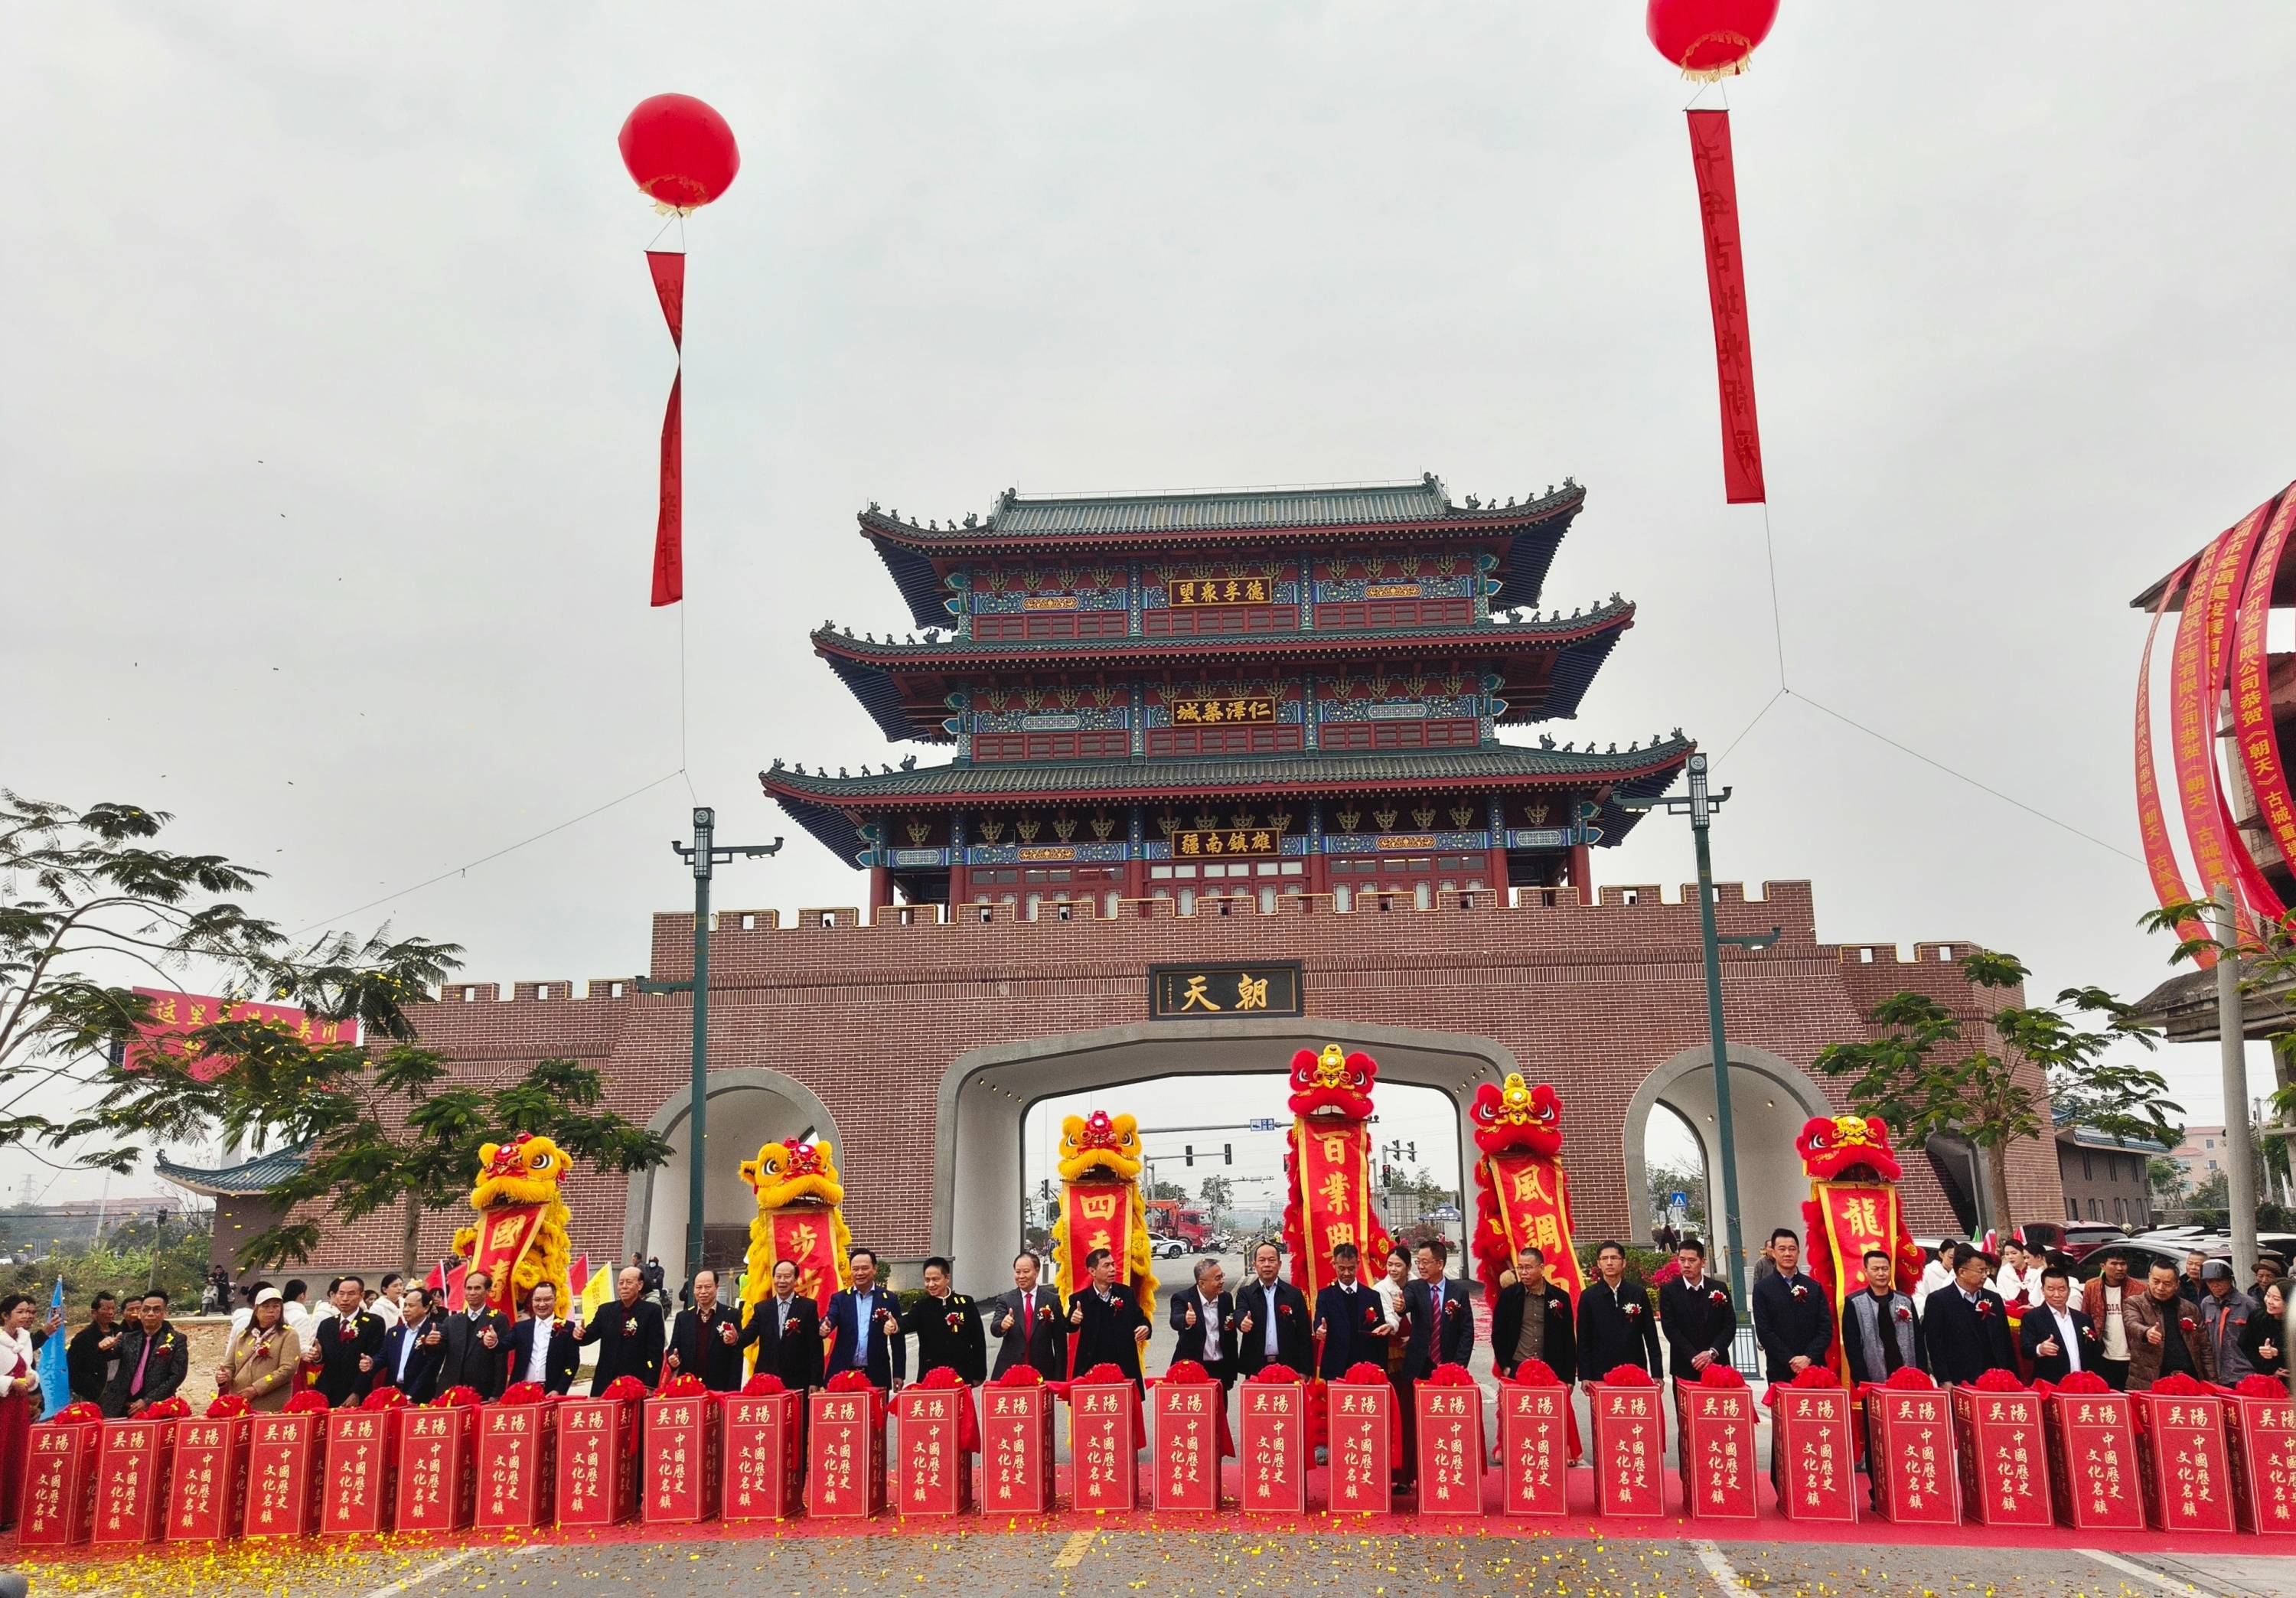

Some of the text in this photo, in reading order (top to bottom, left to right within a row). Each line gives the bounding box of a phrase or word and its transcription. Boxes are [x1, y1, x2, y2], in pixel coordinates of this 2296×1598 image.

[1181, 973, 1268, 1011] 朝天
[263, 1423, 298, 1442] 吴陽
[339, 1420, 373, 1438] 吴陽
[413, 1417, 447, 1436] 吴陽
[491, 1413, 526, 1433] 吴陽
[570, 1410, 604, 1430] 吴陽
[656, 1407, 690, 1426] 吴陽
[736, 1404, 771, 1424] 吴陽
[821, 1401, 856, 1421] 吴陽
[910, 1399, 944, 1418] 吴陽
[993, 1396, 1029, 1415] 吴陽
[1083, 1393, 1119, 1413] 吴陽
[1167, 1392, 1203, 1413] 吴陽
[1253, 1393, 1289, 1414] 吴陽
[1341, 1394, 1377, 1414] 吴陽
[1429, 1394, 1466, 1415] 吴陽
[1517, 1394, 1554, 1416] 吴陽
[1609, 1396, 1647, 1417] 吴陽
[1702, 1397, 1740, 1417] 吴陽
[1796, 1398, 1835, 1420] 吴陽
[1897, 1400, 1936, 1421] 吴陽
[1988, 1401, 2028, 1423] 吴陽
[2077, 1404, 2117, 1425] 吴陽
[2168, 1405, 2209, 1427] 吴陽
[38, 1433, 69, 1451] 吴陽
[113, 1430, 145, 1449] 吴陽
[186, 1427, 220, 1446] 吴陽
[585, 1435, 599, 1497] 中國歷史
[673, 1432, 687, 1494] 中國歷史
[752, 1430, 766, 1492] 中國歷史
[837, 1427, 852, 1489] 中國歷史
[927, 1424, 941, 1487] 中國歷史
[1012, 1421, 1026, 1485] 中國歷史
[1087, 1435, 1102, 1497] 文化名鎮
[1101, 1419, 1117, 1482] 中國歷史
[1170, 1434, 1186, 1497] 文化名鎮
[1185, 1418, 1200, 1482] 中國歷史
[1256, 1435, 1271, 1498] 文化名鎮
[1271, 1420, 1287, 1484] 中國歷史
[1358, 1420, 1374, 1485] 中國歷史
[1450, 1421, 1466, 1485] 中國歷史
[1536, 1422, 1551, 1487] 中國歷史
[1631, 1423, 1648, 1488] 中國歷史
[1724, 1424, 1740, 1490] 中國歷史
[1818, 1426, 1836, 1492] 中國歷史
[1920, 1427, 1939, 1495] 中國歷史
[2012, 1430, 2033, 1497] 中國歷史
[2102, 1431, 2124, 1499] 中國歷史
[47, 1458, 63, 1518] 中國歷史
[123, 1455, 139, 1516] 中國歷史
[181, 1468, 198, 1528] 文化名鎮
[197, 1453, 214, 1513] 中國歷史
[259, 1463, 276, 1524] 文化名鎮
[276, 1448, 292, 1509] 中國歷史
[336, 1459, 353, 1520] 文化名鎮
[352, 1444, 368, 1506] 中國歷史
[411, 1458, 427, 1518] 文化名鎮
[426, 1442, 442, 1503] 中國歷史
[491, 1454, 507, 1515] 文化名鎮
[506, 1438, 521, 1501] 中國歷史
[570, 1451, 585, 1512] 文化名鎮
[658, 1448, 673, 1508] 文化名鎮
[738, 1446, 752, 1506] 文化名鎮
[823, 1443, 838, 1504] 文化名鎮
[912, 1440, 928, 1502] 文化名鎮
[997, 1437, 1013, 1499] 文化名鎮
[1344, 1436, 1359, 1499] 文化名鎮
[1433, 1437, 1450, 1500] 文化名鎮
[1520, 1437, 1536, 1501] 文化名鎮
[1615, 1439, 1632, 1503] 文化名鎮
[1707, 1440, 1725, 1504] 文化名鎮
[1802, 1441, 1821, 1506] 文化名鎮
[1903, 1444, 1923, 1509] 文化名鎮
[1996, 1446, 2017, 1511] 文化名鎮
[2086, 1448, 2108, 1514] 文化名鎮
[2176, 1450, 2197, 1517] 文化名鎮
[2192, 1433, 2213, 1502] 中國歷史
[2268, 1453, 2291, 1519] 文化名鎮
[31, 1473, 49, 1532] 文化名鎮
[108, 1470, 125, 1530] 文化名鎮
